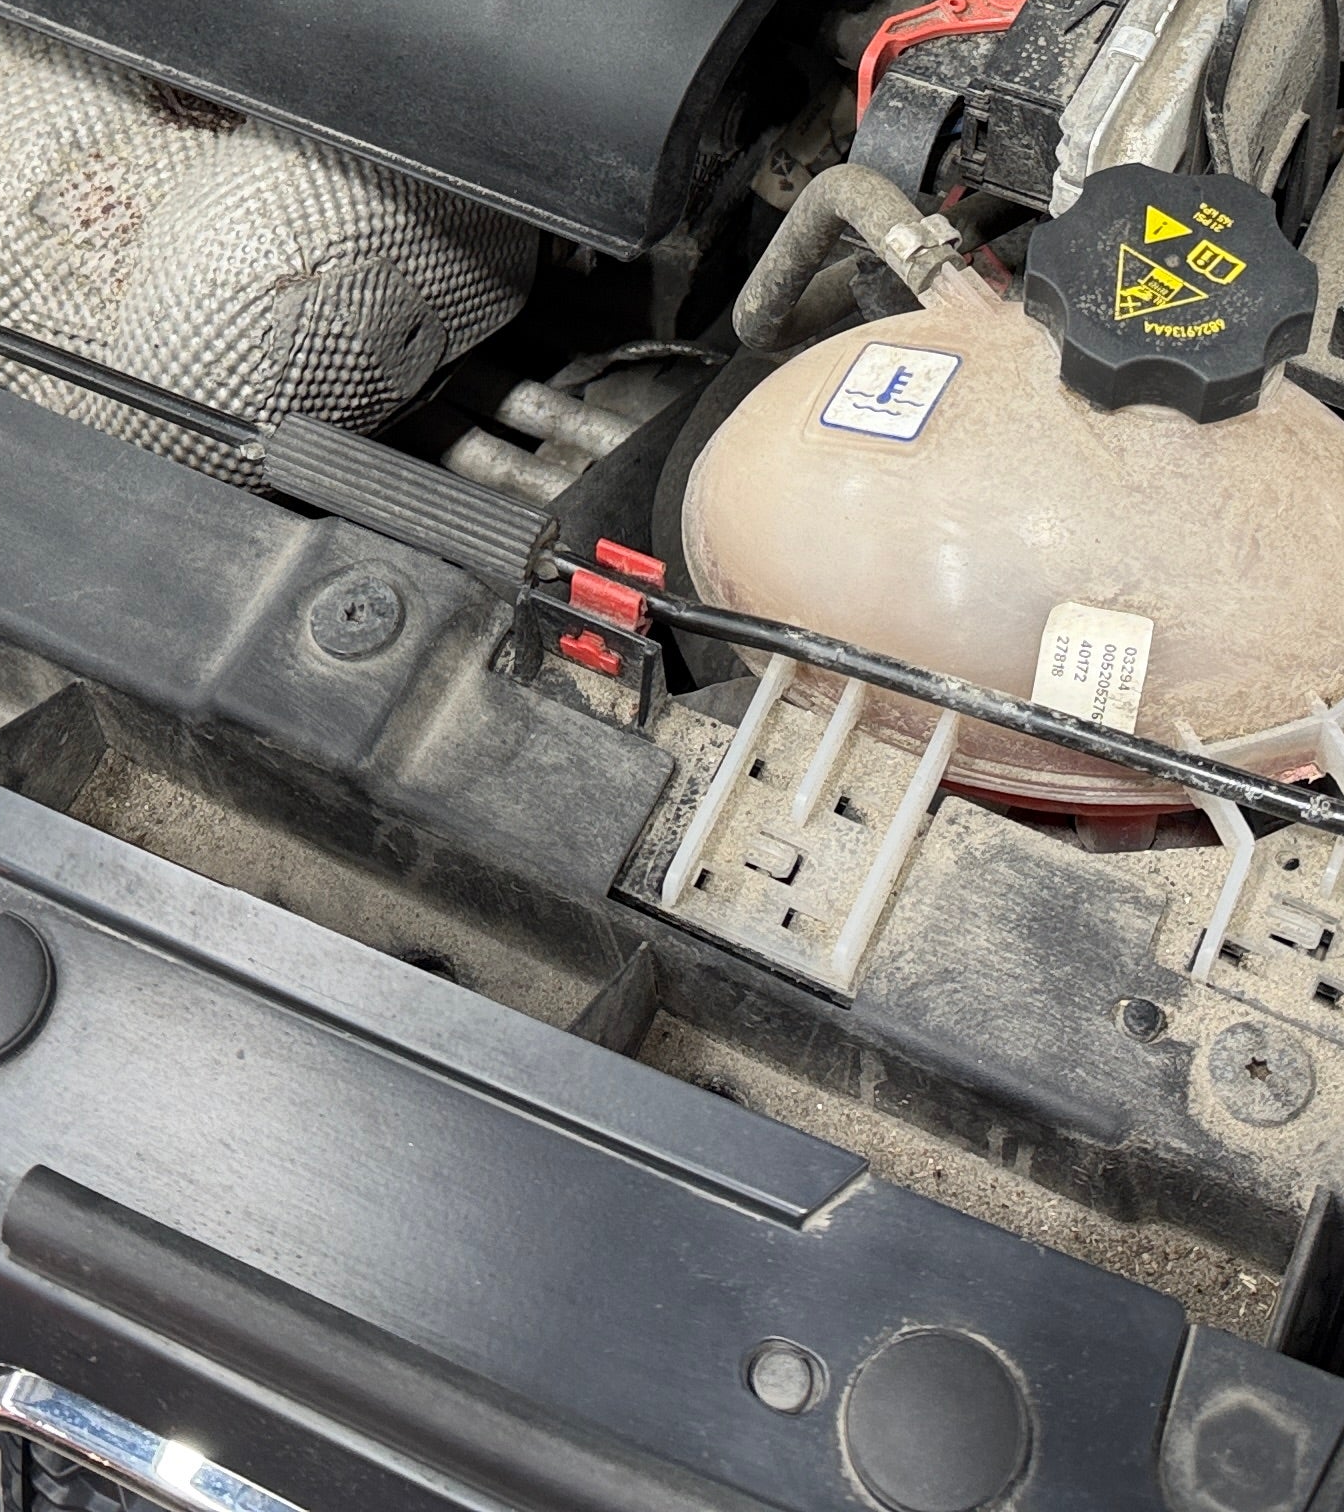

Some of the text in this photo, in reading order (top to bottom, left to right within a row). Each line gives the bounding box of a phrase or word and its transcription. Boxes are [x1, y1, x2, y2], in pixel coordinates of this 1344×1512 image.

[1051, 635, 1070, 678] 27818
[1073, 639, 1093, 684] 40172
[1117, 646, 1138, 692] 03294
